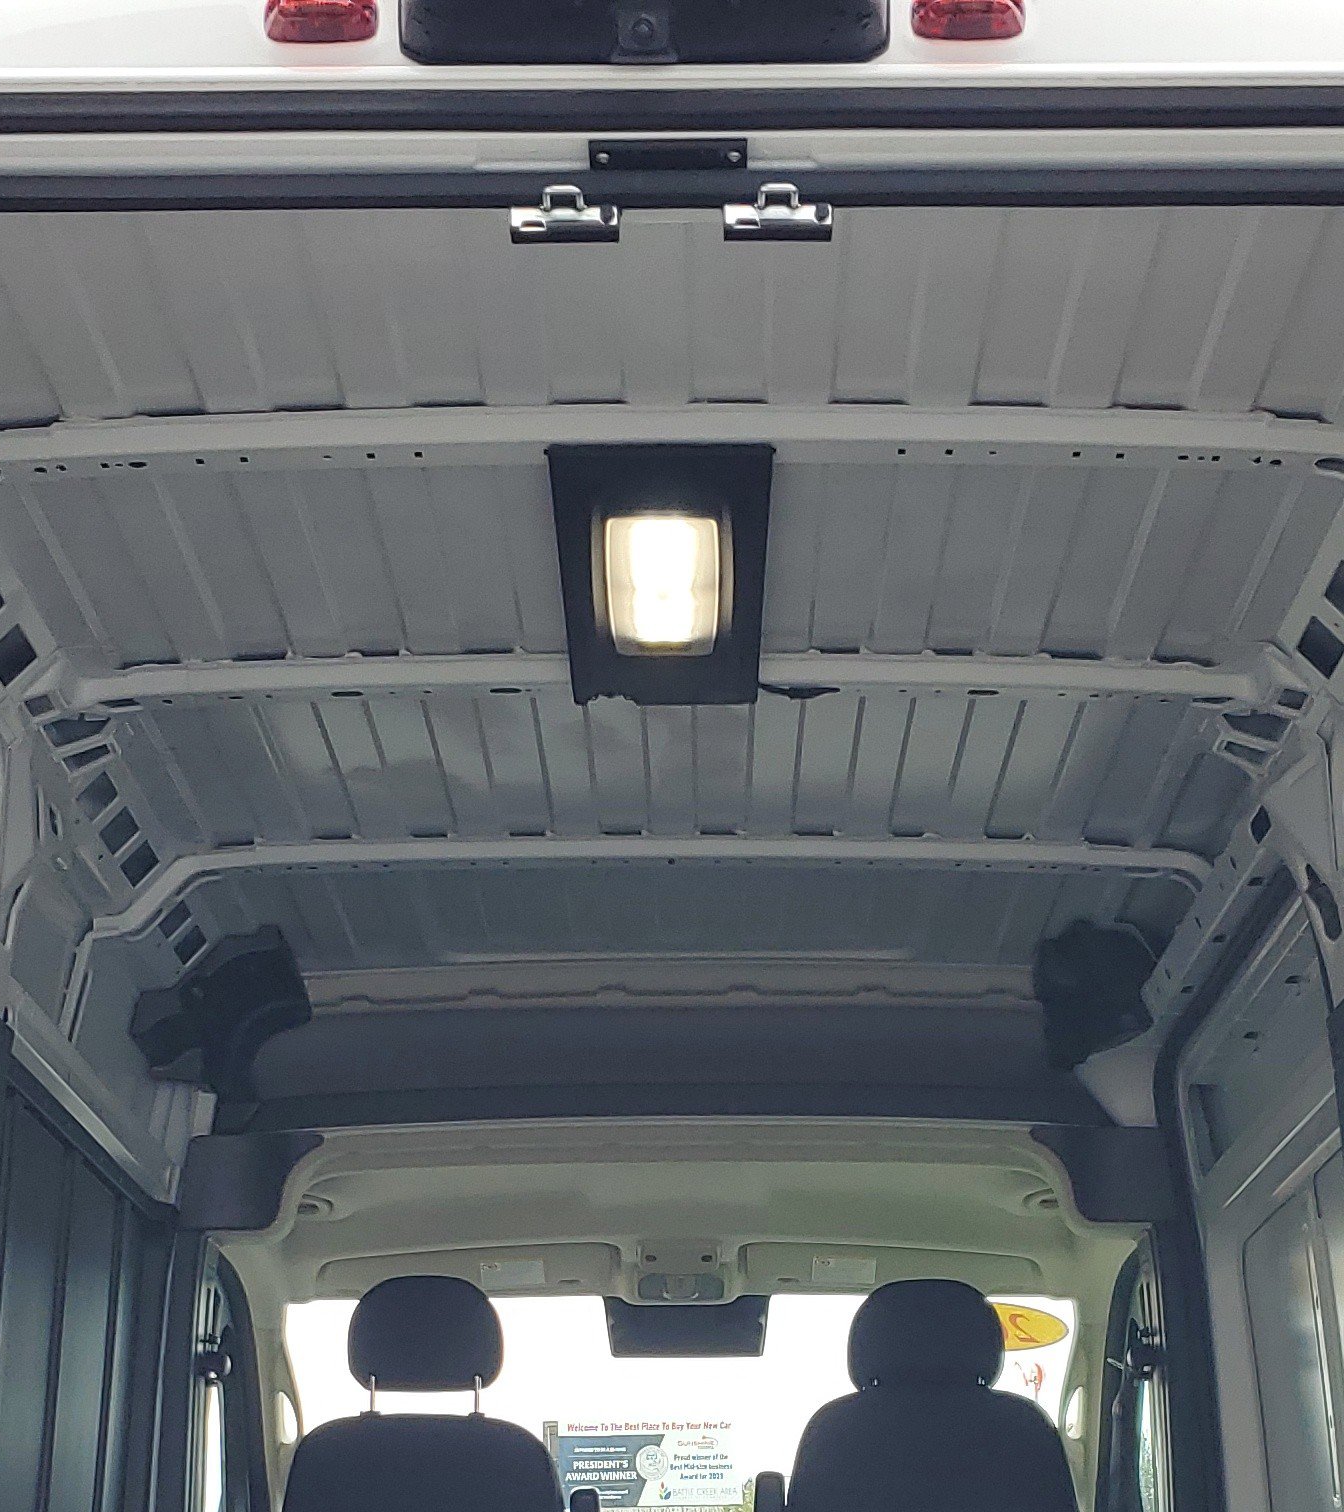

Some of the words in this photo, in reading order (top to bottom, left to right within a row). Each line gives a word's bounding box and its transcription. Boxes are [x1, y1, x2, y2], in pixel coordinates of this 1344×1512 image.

[567, 1423, 599, 1432] Welcome
[600, 1423, 609, 1432] To
[610, 1423, 623, 1432] The
[624, 1422, 640, 1431] Best
[641, 1422, 660, 1431] Place
[662, 1422, 670, 1431] To
[671, 1422, 685, 1432] Buy
[686, 1422, 702, 1430] Your
[703, 1421, 718, 1430] New
[719, 1421, 732, 1429] Car
[673, 1453, 691, 1461] Proud
[691, 1453, 712, 1461] winner
[572, 1459, 629, 1470] PRESIDENT'S
[669, 1463, 683, 1471] Best
[565, 1471, 600, 1481] AWARD
[600, 1471, 638, 1481] WINNER
[679, 1472, 699, 1480] Award
